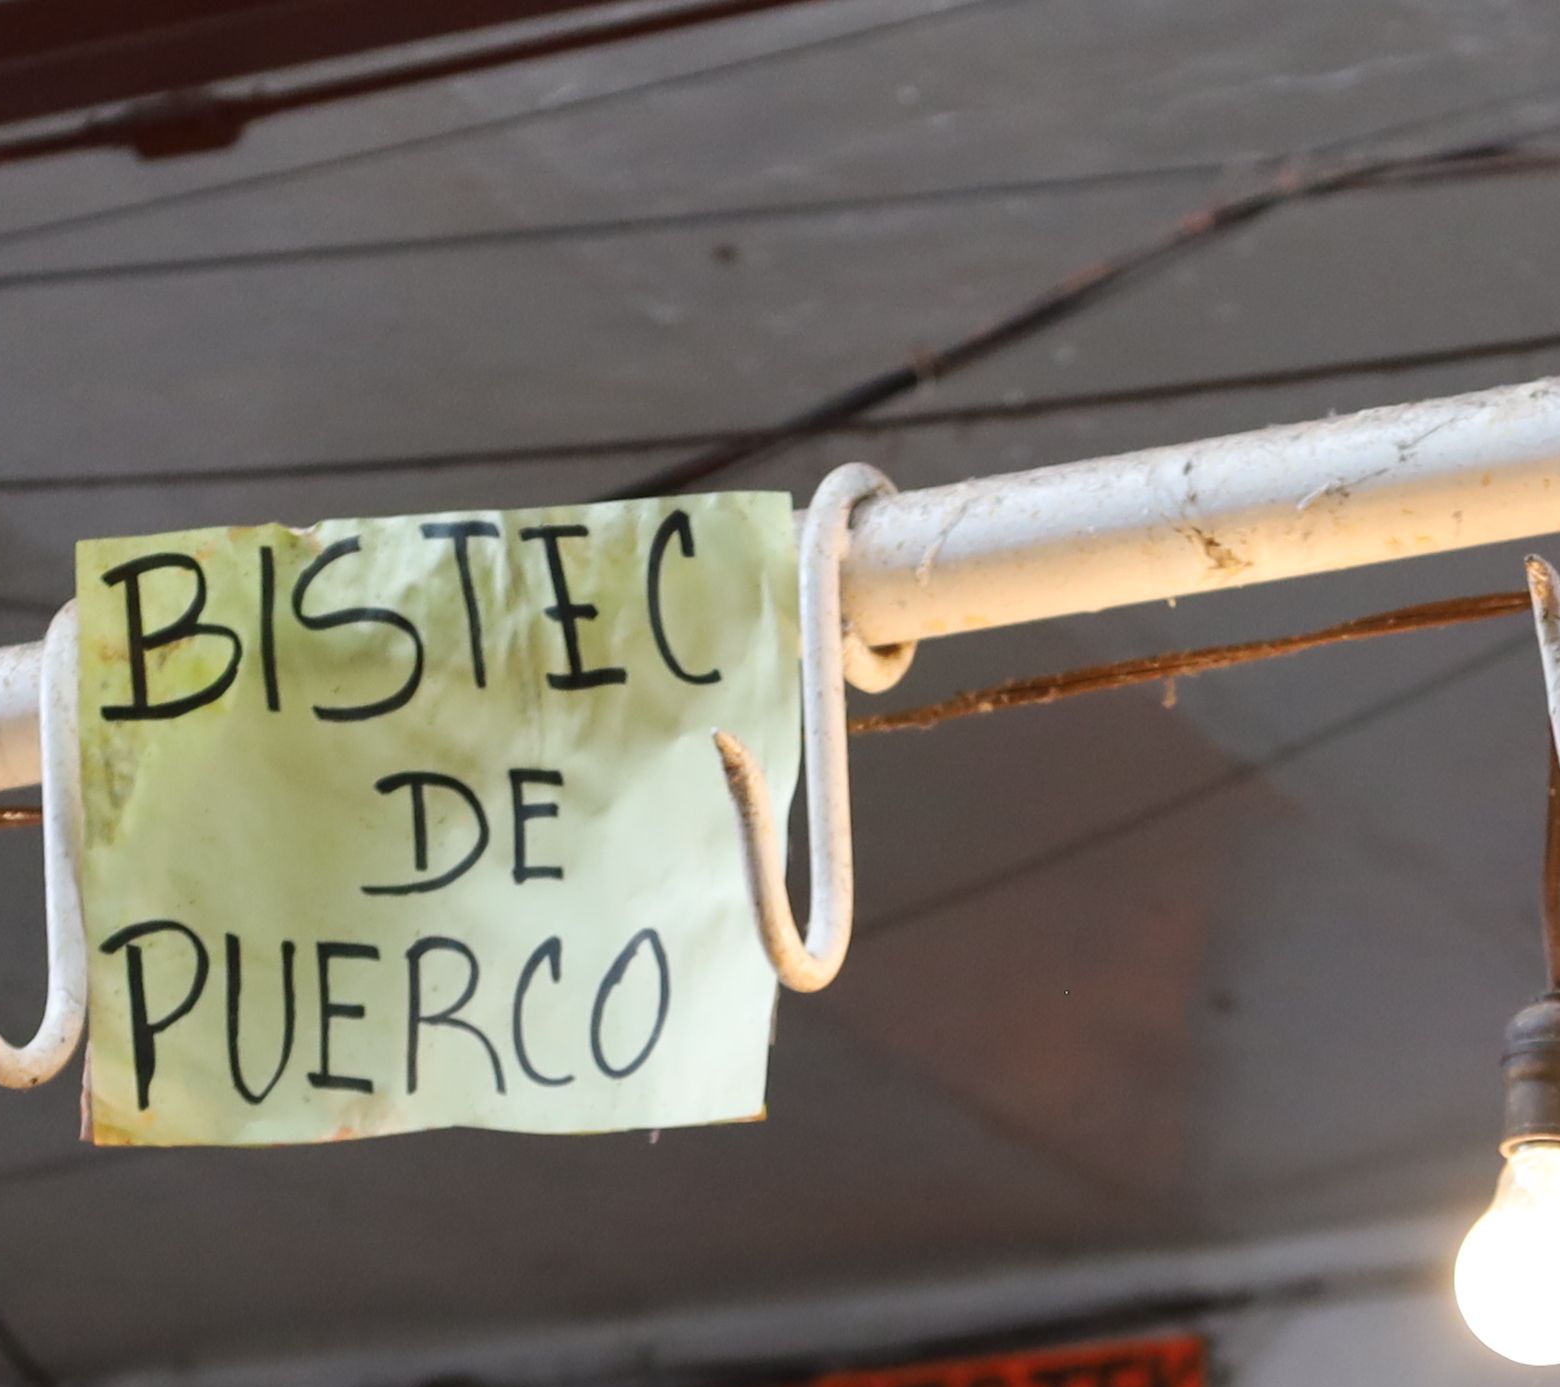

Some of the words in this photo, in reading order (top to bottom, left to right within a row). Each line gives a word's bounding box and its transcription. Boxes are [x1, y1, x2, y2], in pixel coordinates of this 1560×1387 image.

[101, 509, 724, 722] BISTEC
[359, 767, 566, 896] DE
[99, 920, 671, 1112] PUERCO
